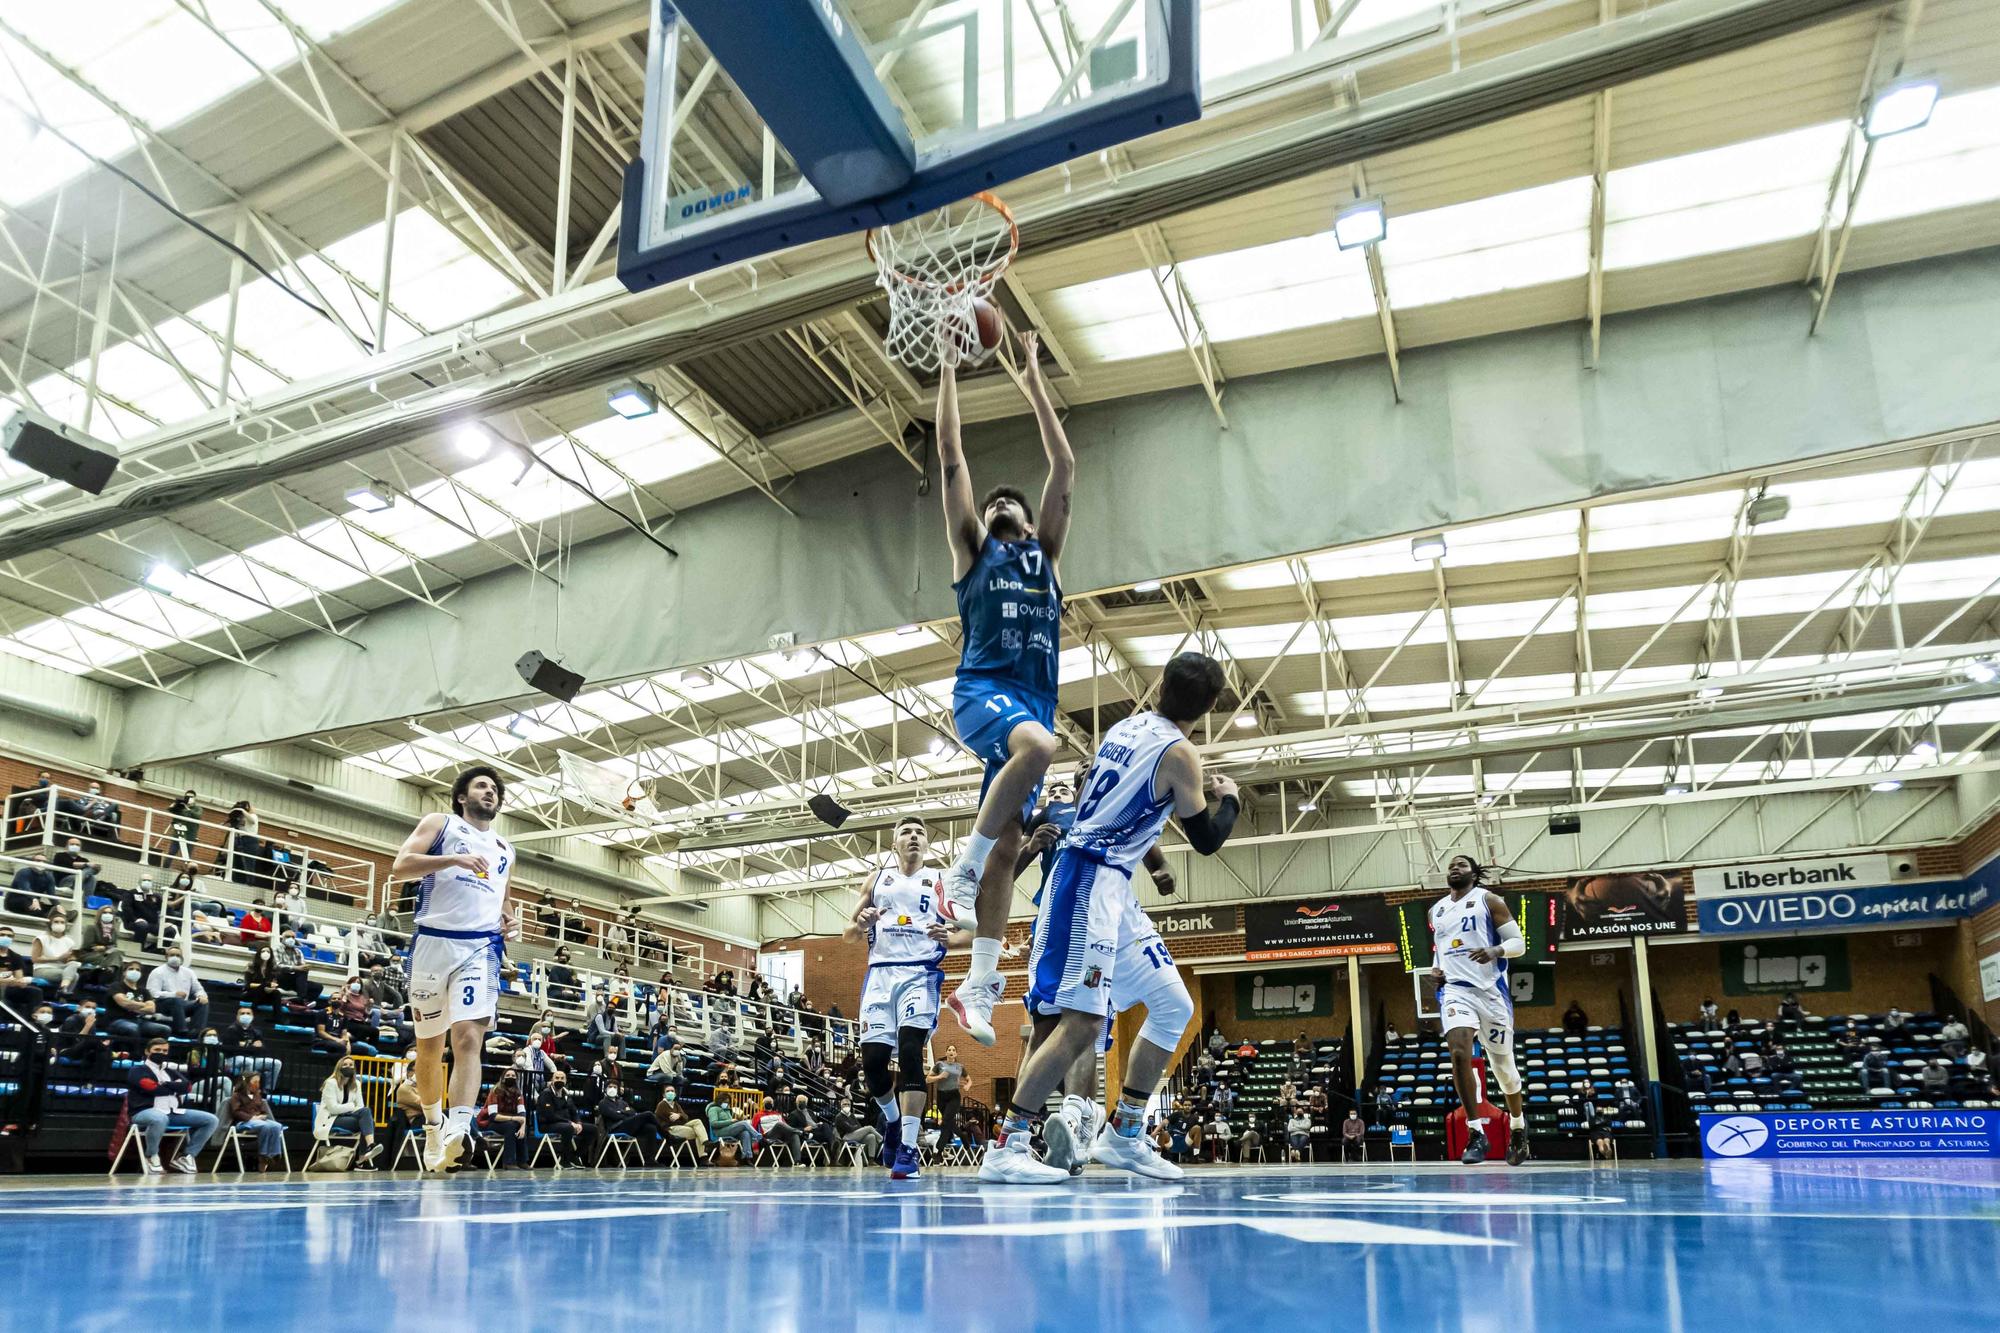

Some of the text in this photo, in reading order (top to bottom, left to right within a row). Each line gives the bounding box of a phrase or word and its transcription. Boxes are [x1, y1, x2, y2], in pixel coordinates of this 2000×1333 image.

[1019, 550, 1043, 576] 17
[985, 694, 1013, 714] 17
[498, 856, 508, 874] 3
[1723, 862, 1857, 890] Liberbank
[919, 894, 931, 913] 5
[1717, 893, 1857, 926] OVIEDO
[1862, 896, 1929, 918] capital
[1461, 915, 1476, 932] 21
[1572, 921, 1676, 936] LA PASIÓN NOS UNE
[1264, 932, 1374, 945] WWW.UNIONFINANCIERA.ES
[1142, 942, 1174, 970] 19
[1251, 952, 1271, 960] DESDE
[1288, 950, 1312, 958] DANDO
[1313, 947, 1342, 956] CRÉDITO
[1343, 947, 1349, 955] A
[1350, 946, 1363, 954] TUS
[1364, 945, 1391, 953] SUEÑOS
[462, 985, 475, 1006] 3
[1488, 1028, 1506, 1044] 21
[1774, 1116, 1986, 1131] DEPORTE ASTURIANO
